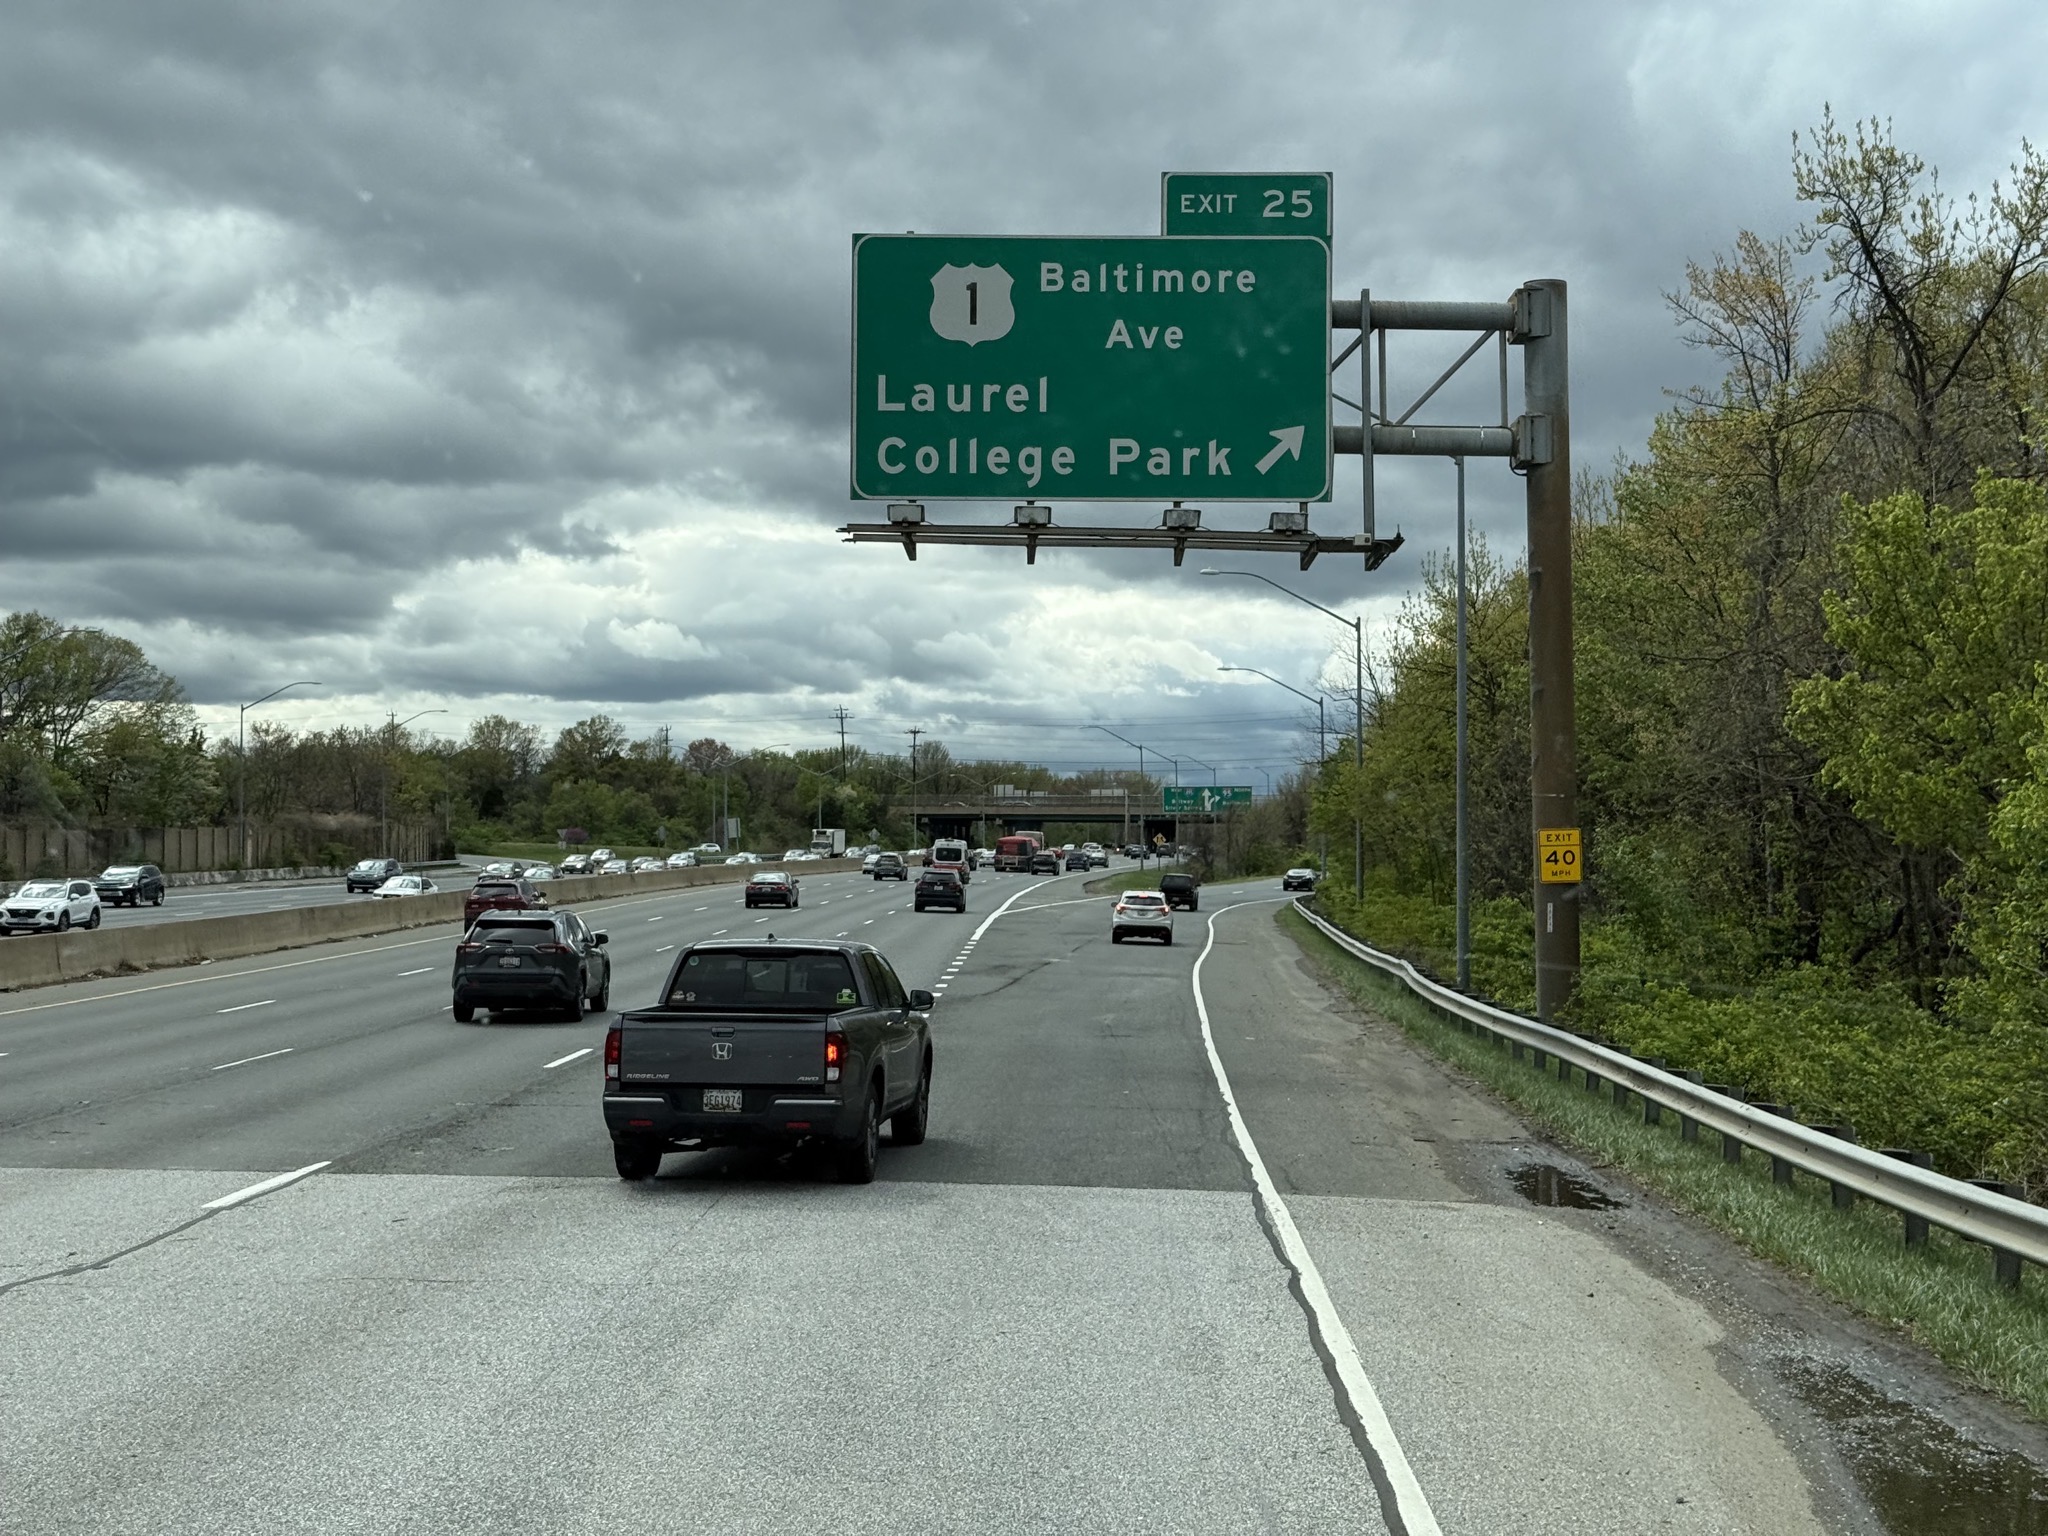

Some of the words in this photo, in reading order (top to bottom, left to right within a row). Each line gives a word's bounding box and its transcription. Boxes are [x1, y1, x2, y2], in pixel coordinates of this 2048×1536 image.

[1180, 194, 1238, 214] EXIT
[1262, 189, 1313, 218] 25
[1040, 261, 1256, 293] Baltimore
[965, 282, 978, 326] 1
[1105, 319, 1184, 350] Ave
[877, 374, 1048, 413] Laurel
[877, 436, 1076, 489] College
[1109, 438, 1232, 477] Park
[1546, 833, 1573, 842] EXIT
[1545, 850, 1576, 866] 40
[1551, 869, 1571, 877] MPH
